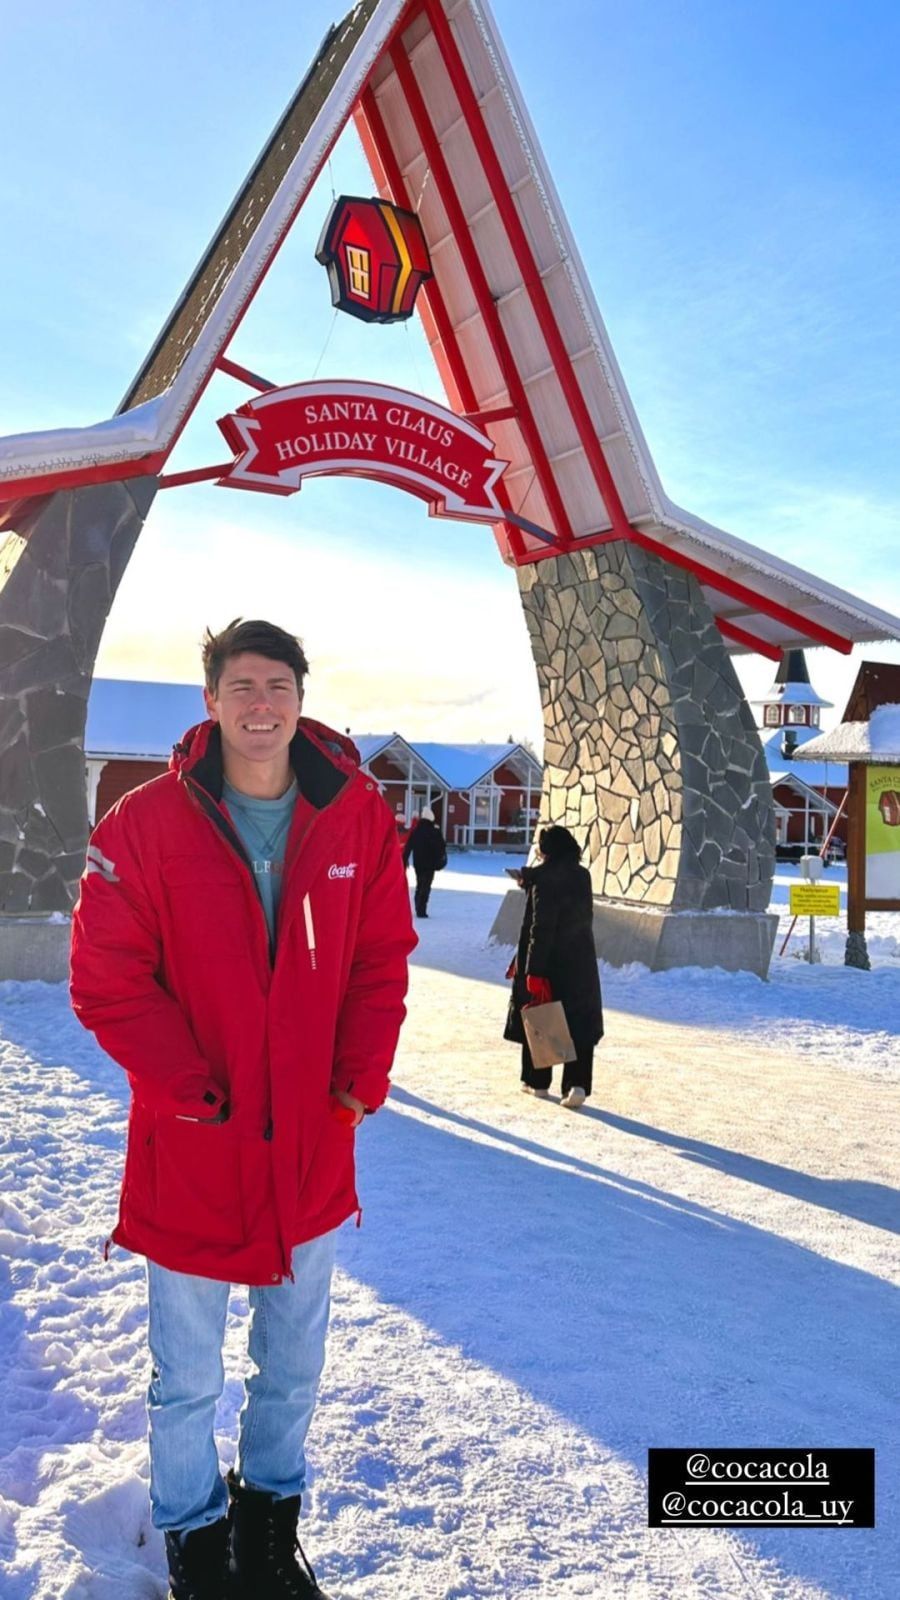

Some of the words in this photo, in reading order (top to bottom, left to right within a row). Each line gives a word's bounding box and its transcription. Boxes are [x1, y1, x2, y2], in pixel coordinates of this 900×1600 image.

[304, 402, 378, 424] SANTA
[386, 407, 455, 447] CLAUS
[275, 432, 378, 461] HOLIDAY
[385, 436, 473, 488] VILLAGE
